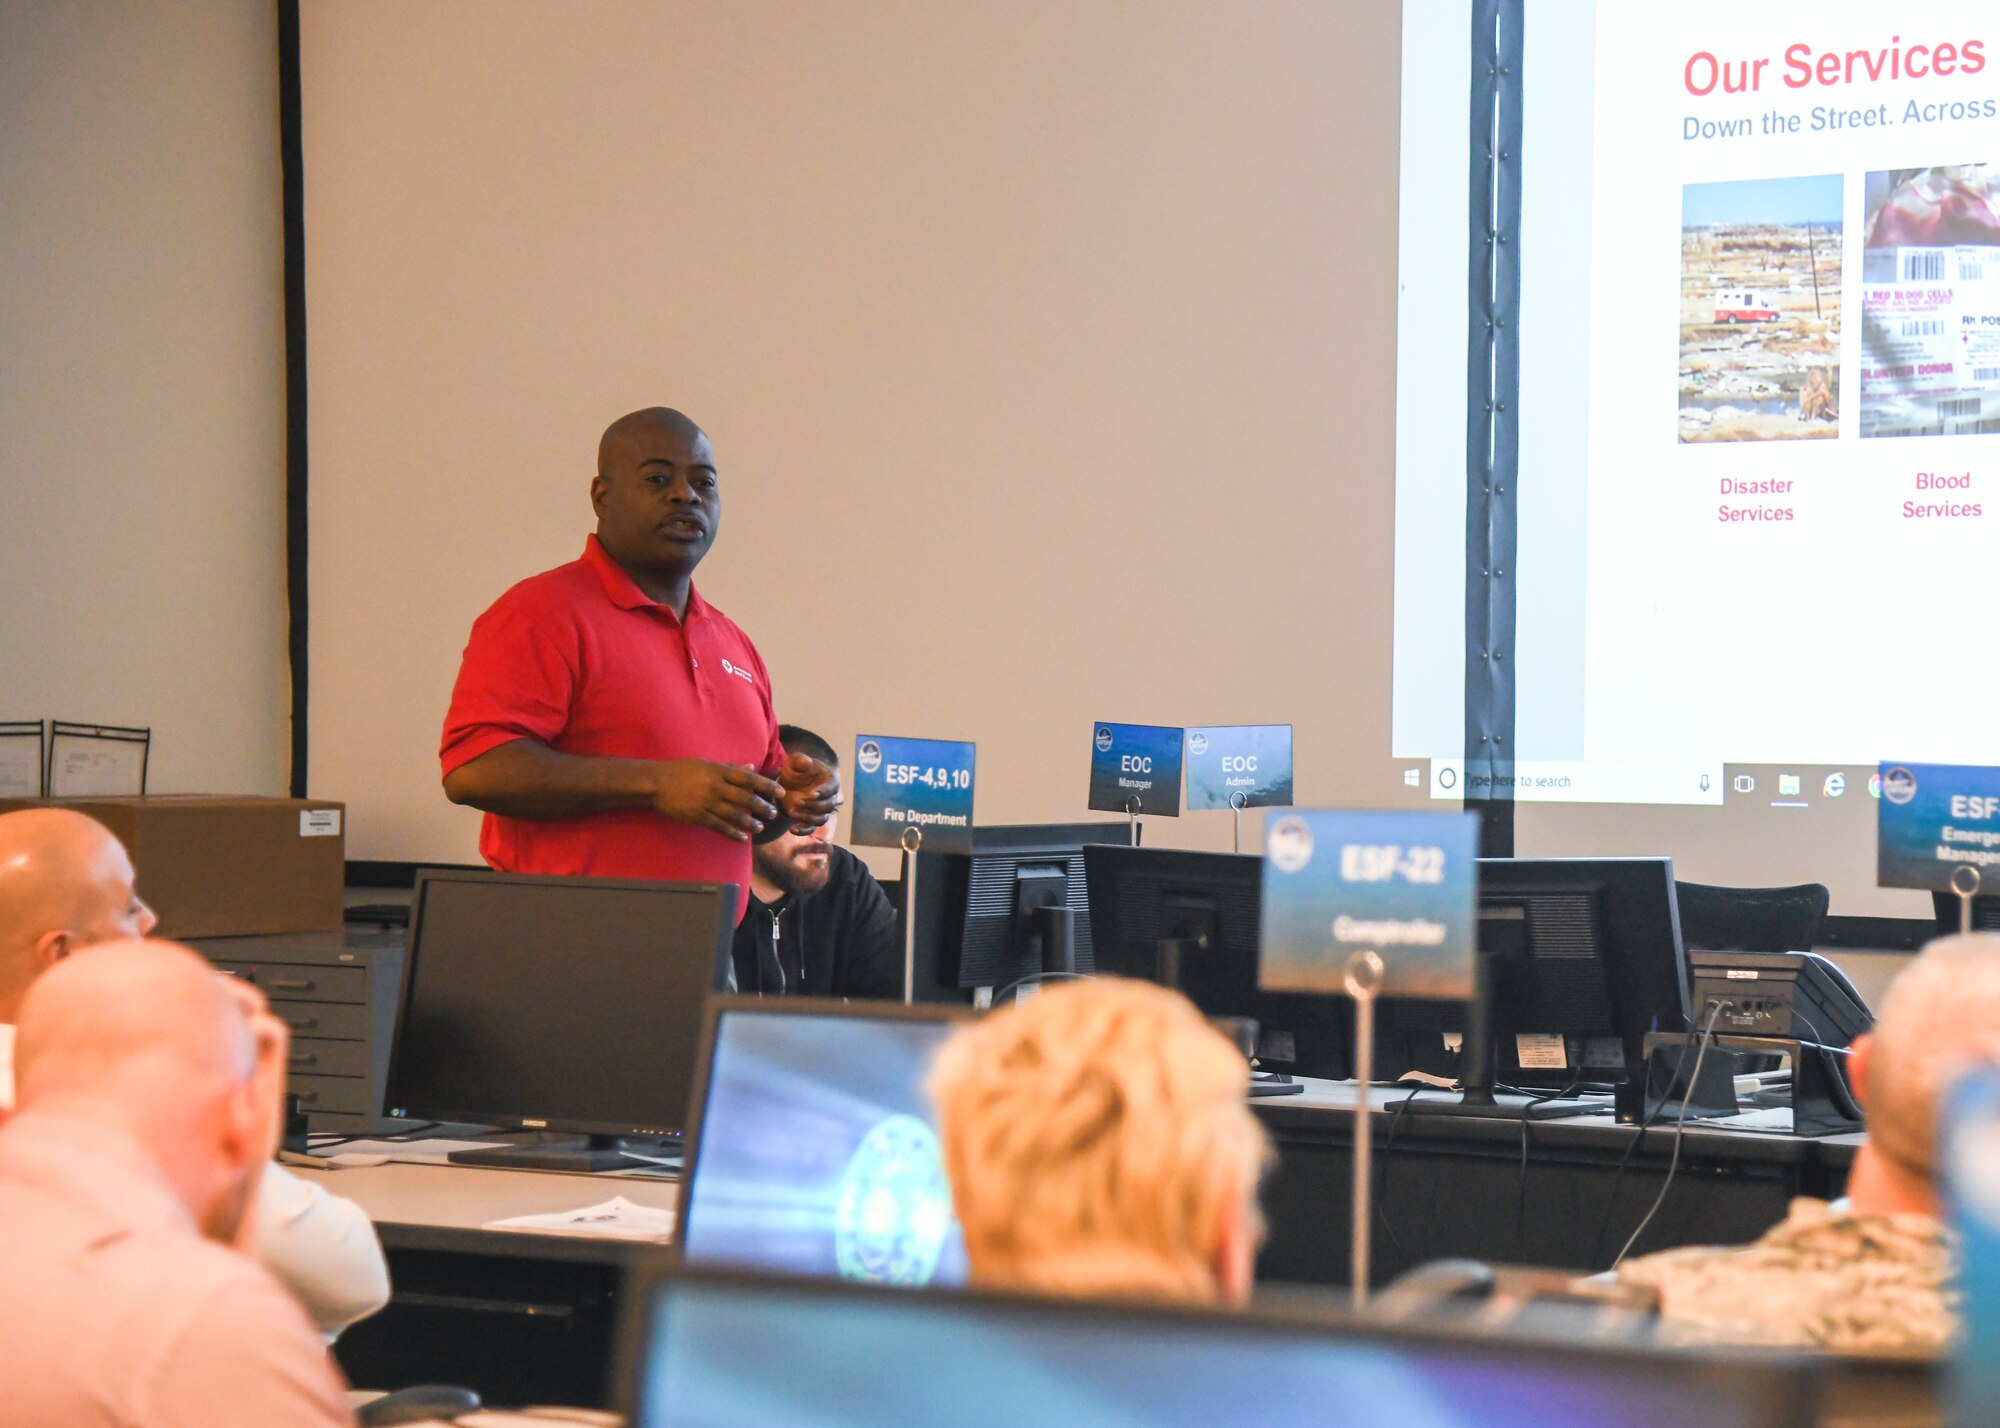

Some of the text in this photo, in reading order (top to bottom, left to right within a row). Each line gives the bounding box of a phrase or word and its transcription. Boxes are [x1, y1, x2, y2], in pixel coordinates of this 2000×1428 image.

[1684, 35, 1986, 96] Our Services
[1683, 99, 1997, 141] Down the Street. Across
[1873, 290, 1891, 300] RED
[1894, 289, 1924, 300] BLOOD
[1926, 288, 1953, 299] CELLS
[1962, 315, 1976, 325] Rh
[1719, 478, 1794, 495] Disaster
[1915, 472, 1971, 490] Blood
[1718, 505, 1795, 522] Services
[1902, 500, 1983, 518] Services
[1121, 755, 1152, 774] EOC
[1221, 756, 1258, 773] EOC
[886, 764, 970, 790] ESF-4,9,10
[1118, 777, 1152, 791] Manager
[1225, 776, 1255, 787] Admin
[1464, 772, 1571, 788] Type here to search
[884, 807, 967, 827] Fire Department
[1942, 825, 2000, 848] Emerge
[1340, 844, 1445, 884] ESF-22
